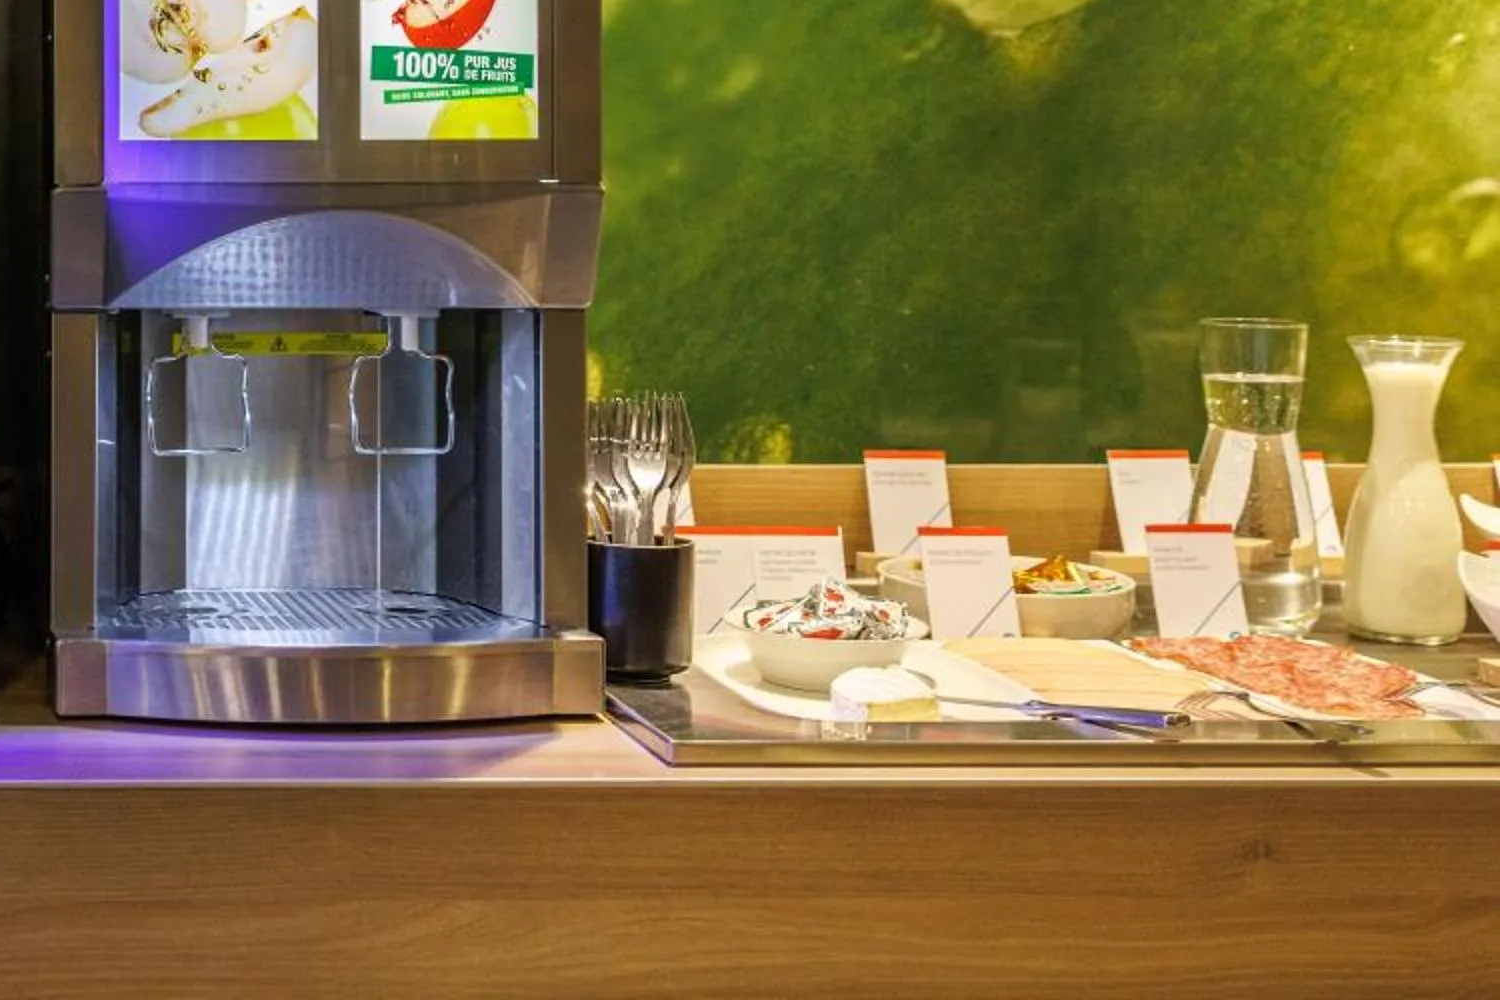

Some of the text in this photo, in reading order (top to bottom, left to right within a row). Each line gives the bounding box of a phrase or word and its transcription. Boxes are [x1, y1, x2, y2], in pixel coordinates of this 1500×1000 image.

[392, 51, 460, 81] 100%
[463, 54, 517, 71] PUR JUS
[463, 69, 516, 82] DE FRUITS
